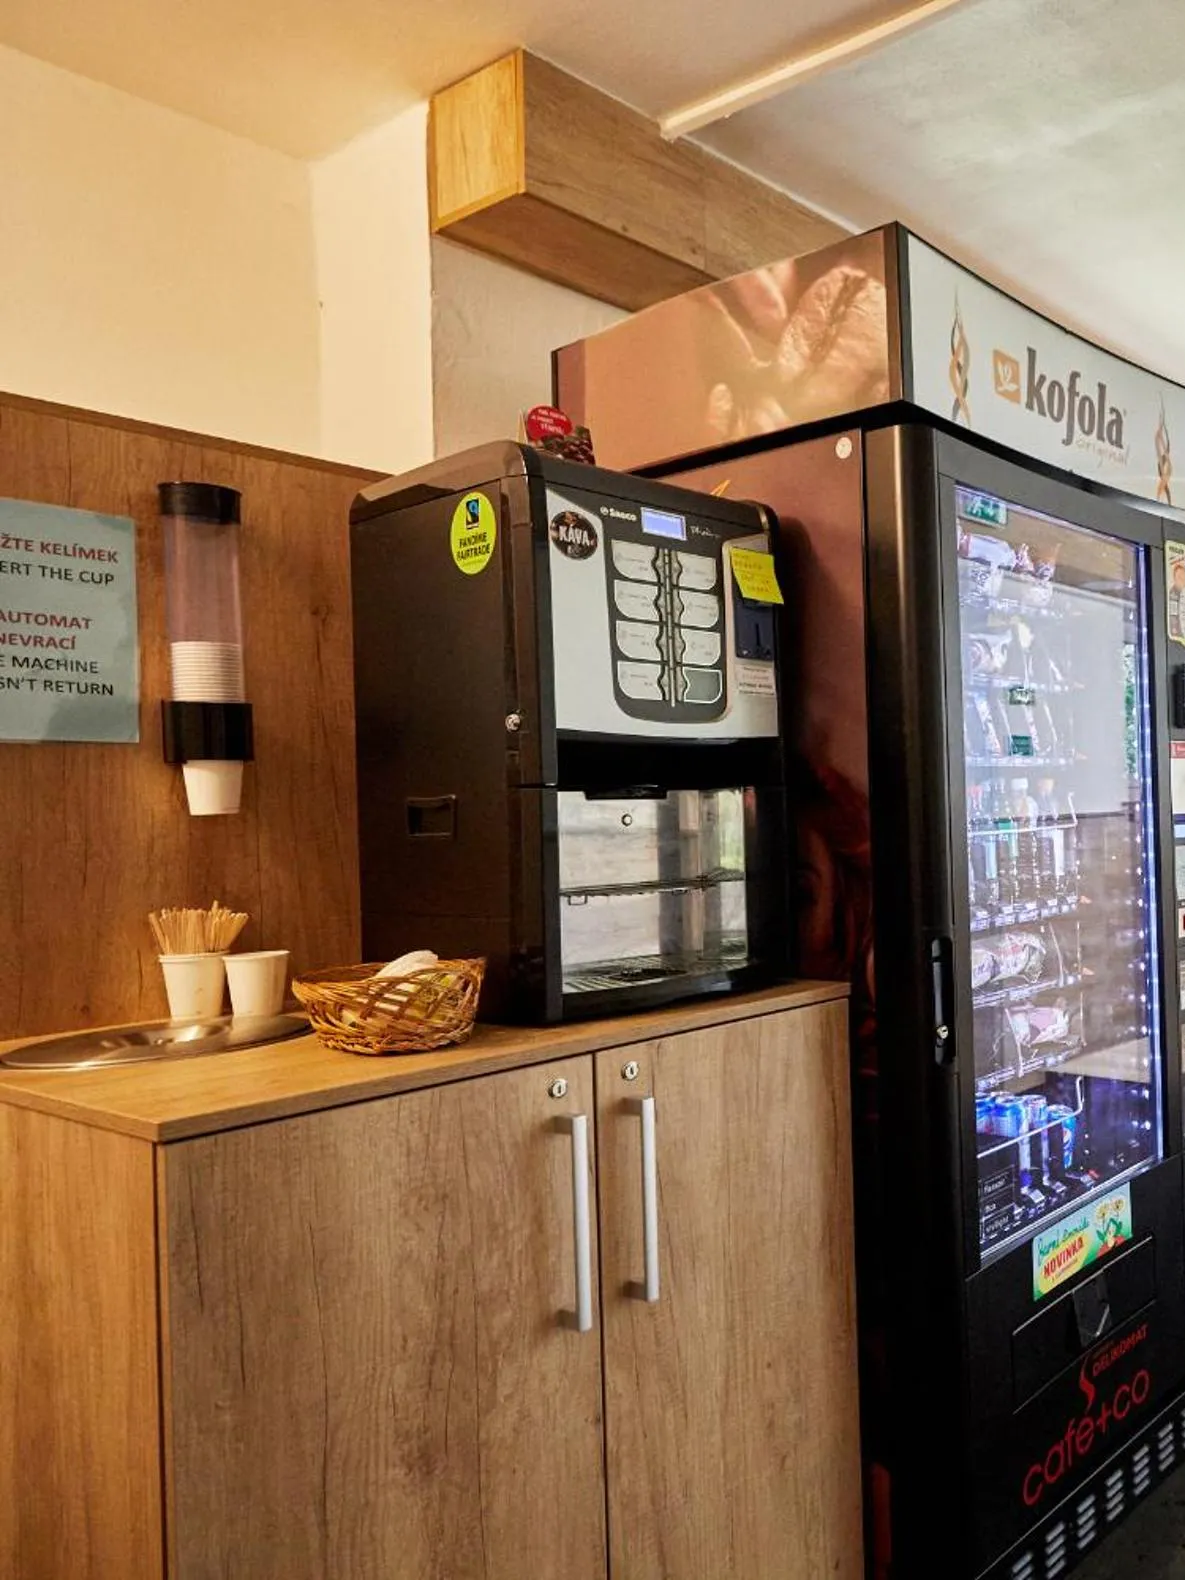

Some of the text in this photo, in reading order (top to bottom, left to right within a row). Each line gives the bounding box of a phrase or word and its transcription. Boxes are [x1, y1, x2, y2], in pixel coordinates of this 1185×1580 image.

[1025, 346, 1125, 449] kofola
[609, 507, 637, 521] Saeco
[559, 523, 590, 547] KÁVA
[40, 541, 119, 563] KELÍMEK
[0, 560, 114, 586] ERT THE CUP
[12, 655, 99, 674] MACHINE
[43, 679, 114, 696] RETURN
[1043, 1236, 1084, 1278] NOVINKA
[1091, 1323, 1149, 1377] DELIKOMAT
